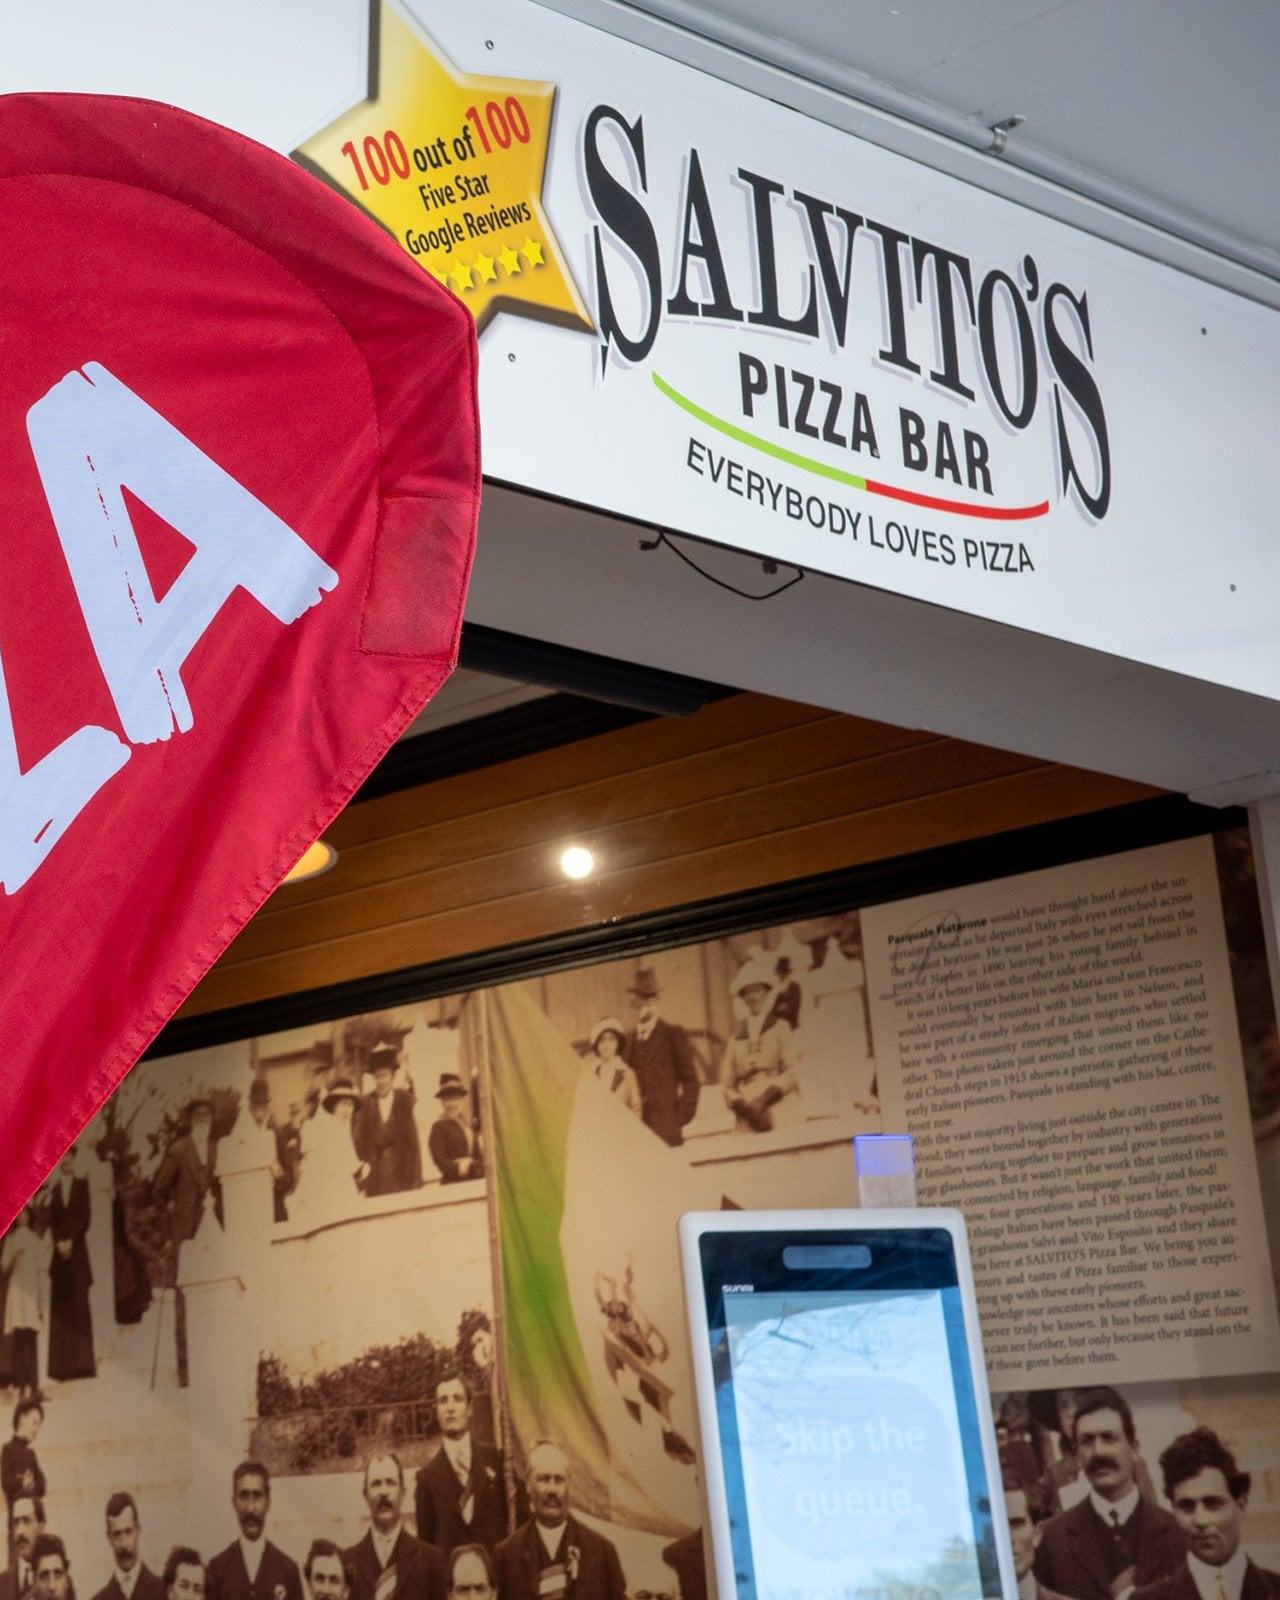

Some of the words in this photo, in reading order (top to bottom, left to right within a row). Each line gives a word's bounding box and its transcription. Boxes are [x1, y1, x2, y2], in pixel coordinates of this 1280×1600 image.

[340, 130, 412, 191] 100
[412, 137, 450, 174] out
[452, 125, 476, 164] of
[465, 95, 531, 156] 100
[418, 178, 452, 212] Five
[454, 171, 491, 202] Star
[405, 212, 465, 258] Google
[465, 200, 532, 239] Reviews
[584, 104, 1112, 523] SALVITO'S
[738, 352, 880, 459] PIZZA
[901, 407, 995, 497] BAR
[687, 437, 864, 542] EVERYBODY
[869, 515, 957, 568] LOVES
[964, 536, 1035, 576] PIZZA
[887, 928, 934, 944] Pasquale
[990, 908, 1020, 923] would
[1022, 907, 1045, 917] have
[1048, 896, 1088, 912] thought
[1090, 889, 1115, 903] hard
[1118, 884, 1147, 898] about
[1150, 881, 1168, 891] the
[897, 1023, 927, 1037] would
[930, 1014, 978, 1032] eventually
[982, 1012, 994, 1022] be
[998, 1003, 1040, 1019] reunited
[1044, 999, 1066, 1011] with
[1070, 996, 1092, 1007] him
[1096, 992, 1118, 1002] here
[1123, 989, 1134, 998] in
[1138, 982, 1180, 994] Nelson,
[1183, 974, 1204, 987] and
[898, 1043, 910, 1053] he
[913, 1042, 931, 1050] was
[934, 1036, 953, 1050] part
[956, 1032, 966, 1043] of
[978, 1026, 1008, 1040] steady
[1012, 1021, 1041, 1033] influx
[1044, 1017, 1054, 1028] of
[1058, 1013, 1091, 1026] Italian
[1094, 1005, 1140, 1020] migrants
[1144, 999, 1167, 1010] who
[1171, 991, 1206, 1006] settled
[900, 1059, 921, 1069] here
[925, 1052, 946, 1064] with
[951, 1053, 956, 1061] a
[960, 1043, 1016, 1059] community
[1021, 1034, 1069, 1049] emerging
[1073, 1029, 1093, 1039] that
[1098, 1020, 1132, 1036] united
[1136, 1018, 1165, 1029] them
[1169, 1012, 1188, 1024] like
[1194, 1011, 1209, 1020] no
[902, 1073, 930, 1084] other.
[933, 1068, 953, 1079] This
[956, 1065, 984, 1079] photo
[987, 1059, 1014, 1070] taken
[1017, 1055, 1035, 1068] just
[1039, 1047, 1075, 1062] around
[1078, 1045, 1095, 1056] the
[1098, 1040, 1131, 1053] corner
[1135, 1037, 1150, 1046] on
[1153, 1033, 1170, 1043] the
[904, 1088, 923, 1100] dral
[925, 1083, 961, 1096] Church
[964, 1081, 988, 1092] steps
[990, 1078, 1001, 1087] in
[1003, 1071, 1027, 1085] 1915
[1029, 1069, 1060, 1080] shows
[1071, 1060, 1114, 1077] patriotic
[1118, 1051, 1169, 1070] gathering
[1170, 1047, 1182, 1057] of
[1184, 1044, 1213, 1056] these
[905, 1104, 928, 1117] early
[931, 1101, 961, 1112] Italian
[963, 1094, 1007, 1111] pioneers.
[1009, 1085, 1052, 1100] Pasquale
[1055, 1085, 1064, 1093] is
[1066, 1078, 1110, 1091] standing
[1112, 1072, 1136, 1084] with
[1137, 1070, 1154, 1080] his
[1156, 1067, 1176, 1078] hat,
[1178, 1061, 1216, 1074] centre,
[988, 1258, 1010, 1269] here
[1014, 1257, 1023, 1267] at
[1026, 1249, 1086, 1264] SALVITO'S
[1089, 1248, 1116, 1259] Pizza
[1119, 1244, 1141, 1255] Bar.
[1143, 1242, 1160, 1252] We
[1163, 1240, 1194, 1252] bring
[1197, 1237, 1217, 1249] you
[1013, 1323, 1038, 1334] truly
[1041, 1321, 1053, 1332] be
[1057, 1320, 1098, 1330] known.
[1100, 1316, 1108, 1327] It
[1111, 1315, 1130, 1326] has
[1133, 1313, 1159, 1324] been
[1163, 1309, 1185, 1321] said
[1188, 1307, 1210, 1319] that
[1214, 1306, 1249, 1316] future
[775, 1417, 855, 1462] Skip
[863, 1415, 927, 1454] the
[795, 1486, 925, 1526] queue.
